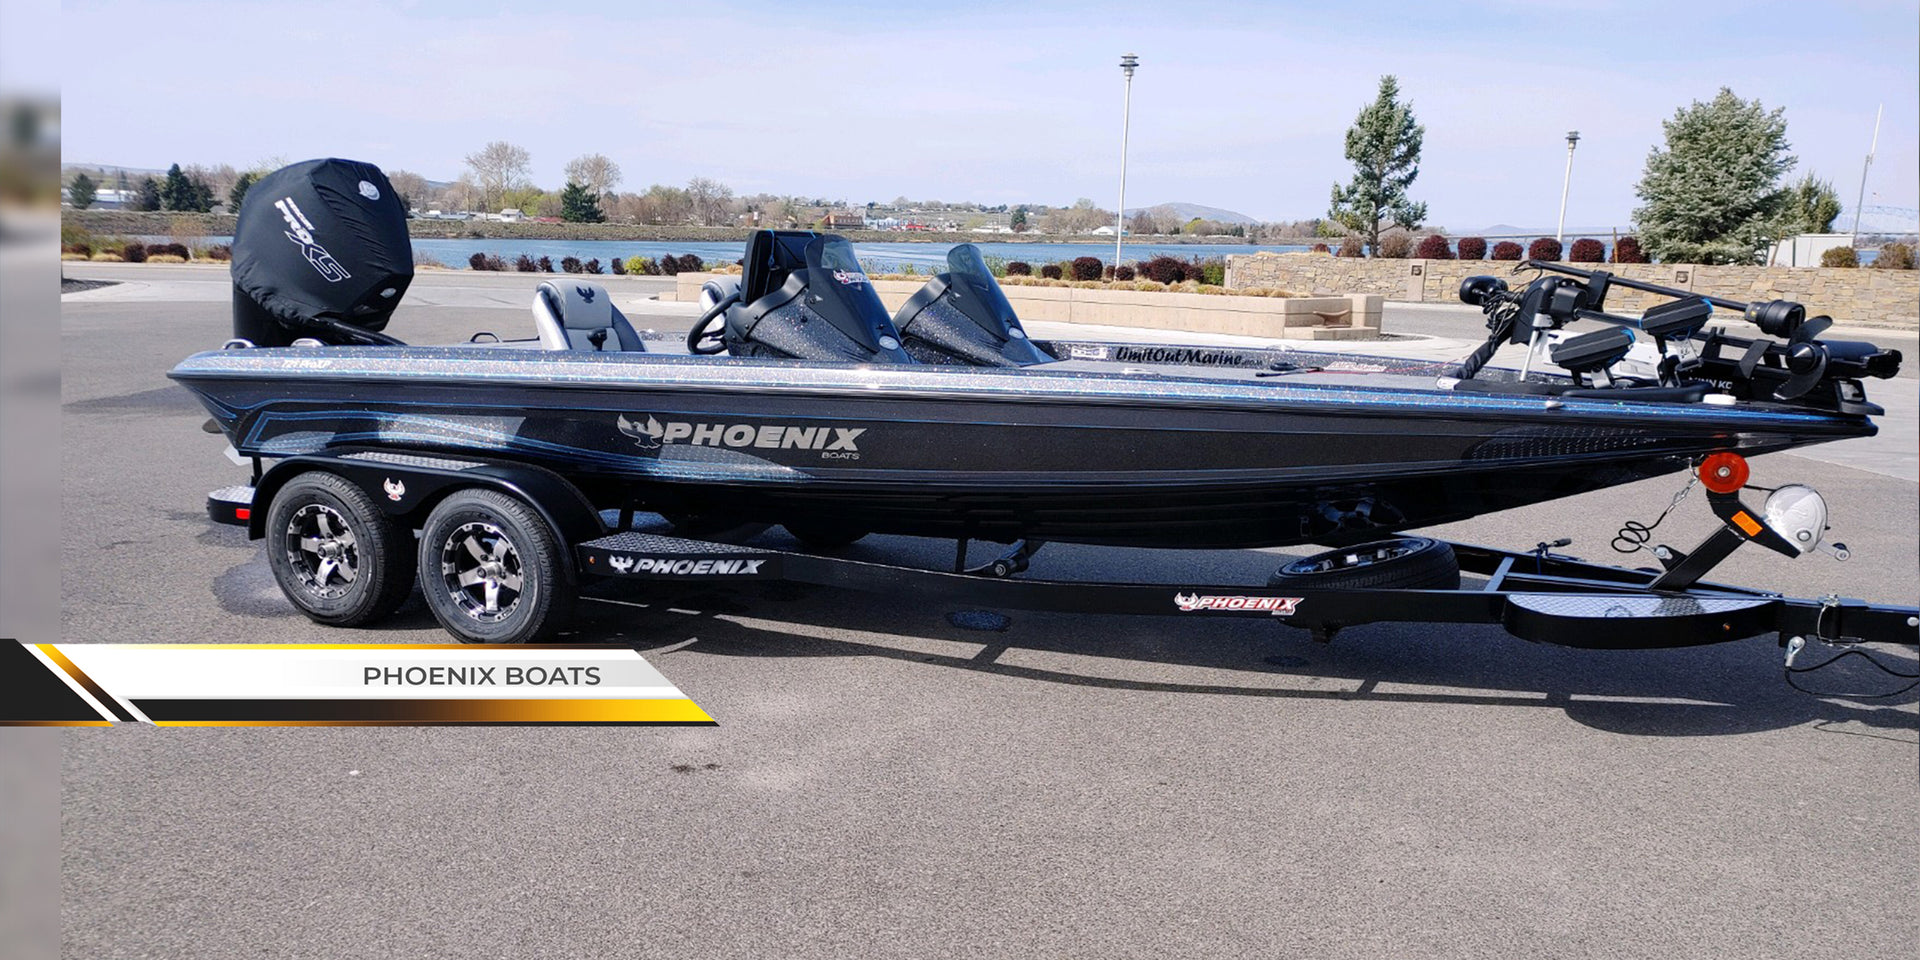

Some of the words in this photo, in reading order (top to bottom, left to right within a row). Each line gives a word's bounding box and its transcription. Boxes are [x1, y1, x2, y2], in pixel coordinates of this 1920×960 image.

[662, 421, 868, 451] PHOENIX
[821, 451, 861, 460] BOATS
[631, 557, 768, 575] PHOENIX
[1198, 595, 1304, 611] PHOENIX
